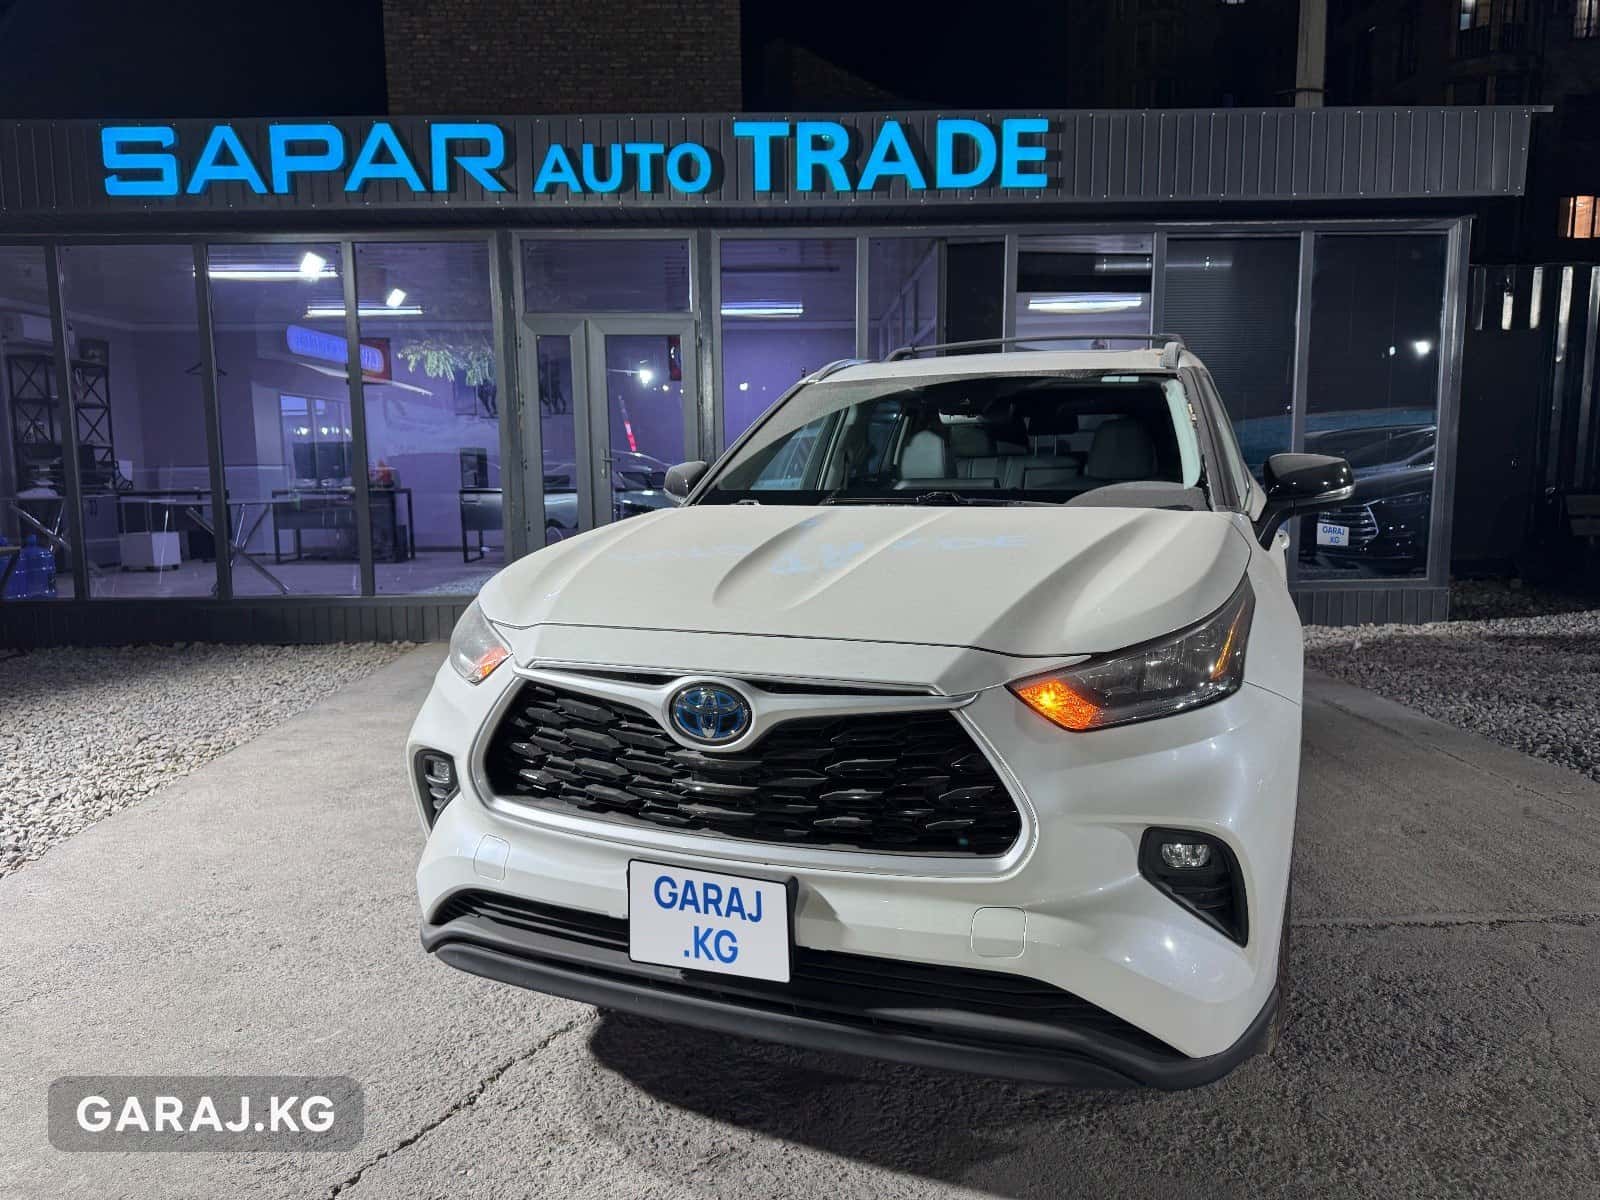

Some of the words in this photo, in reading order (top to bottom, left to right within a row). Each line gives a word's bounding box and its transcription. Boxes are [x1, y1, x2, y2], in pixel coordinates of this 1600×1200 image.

[100, 122, 506, 197] SAPAR
[533, 141, 712, 194] AUTO
[732, 117, 1050, 192] TRADE
[654, 875, 763, 923] GARAJ
[683, 926, 739, 964] .KG
